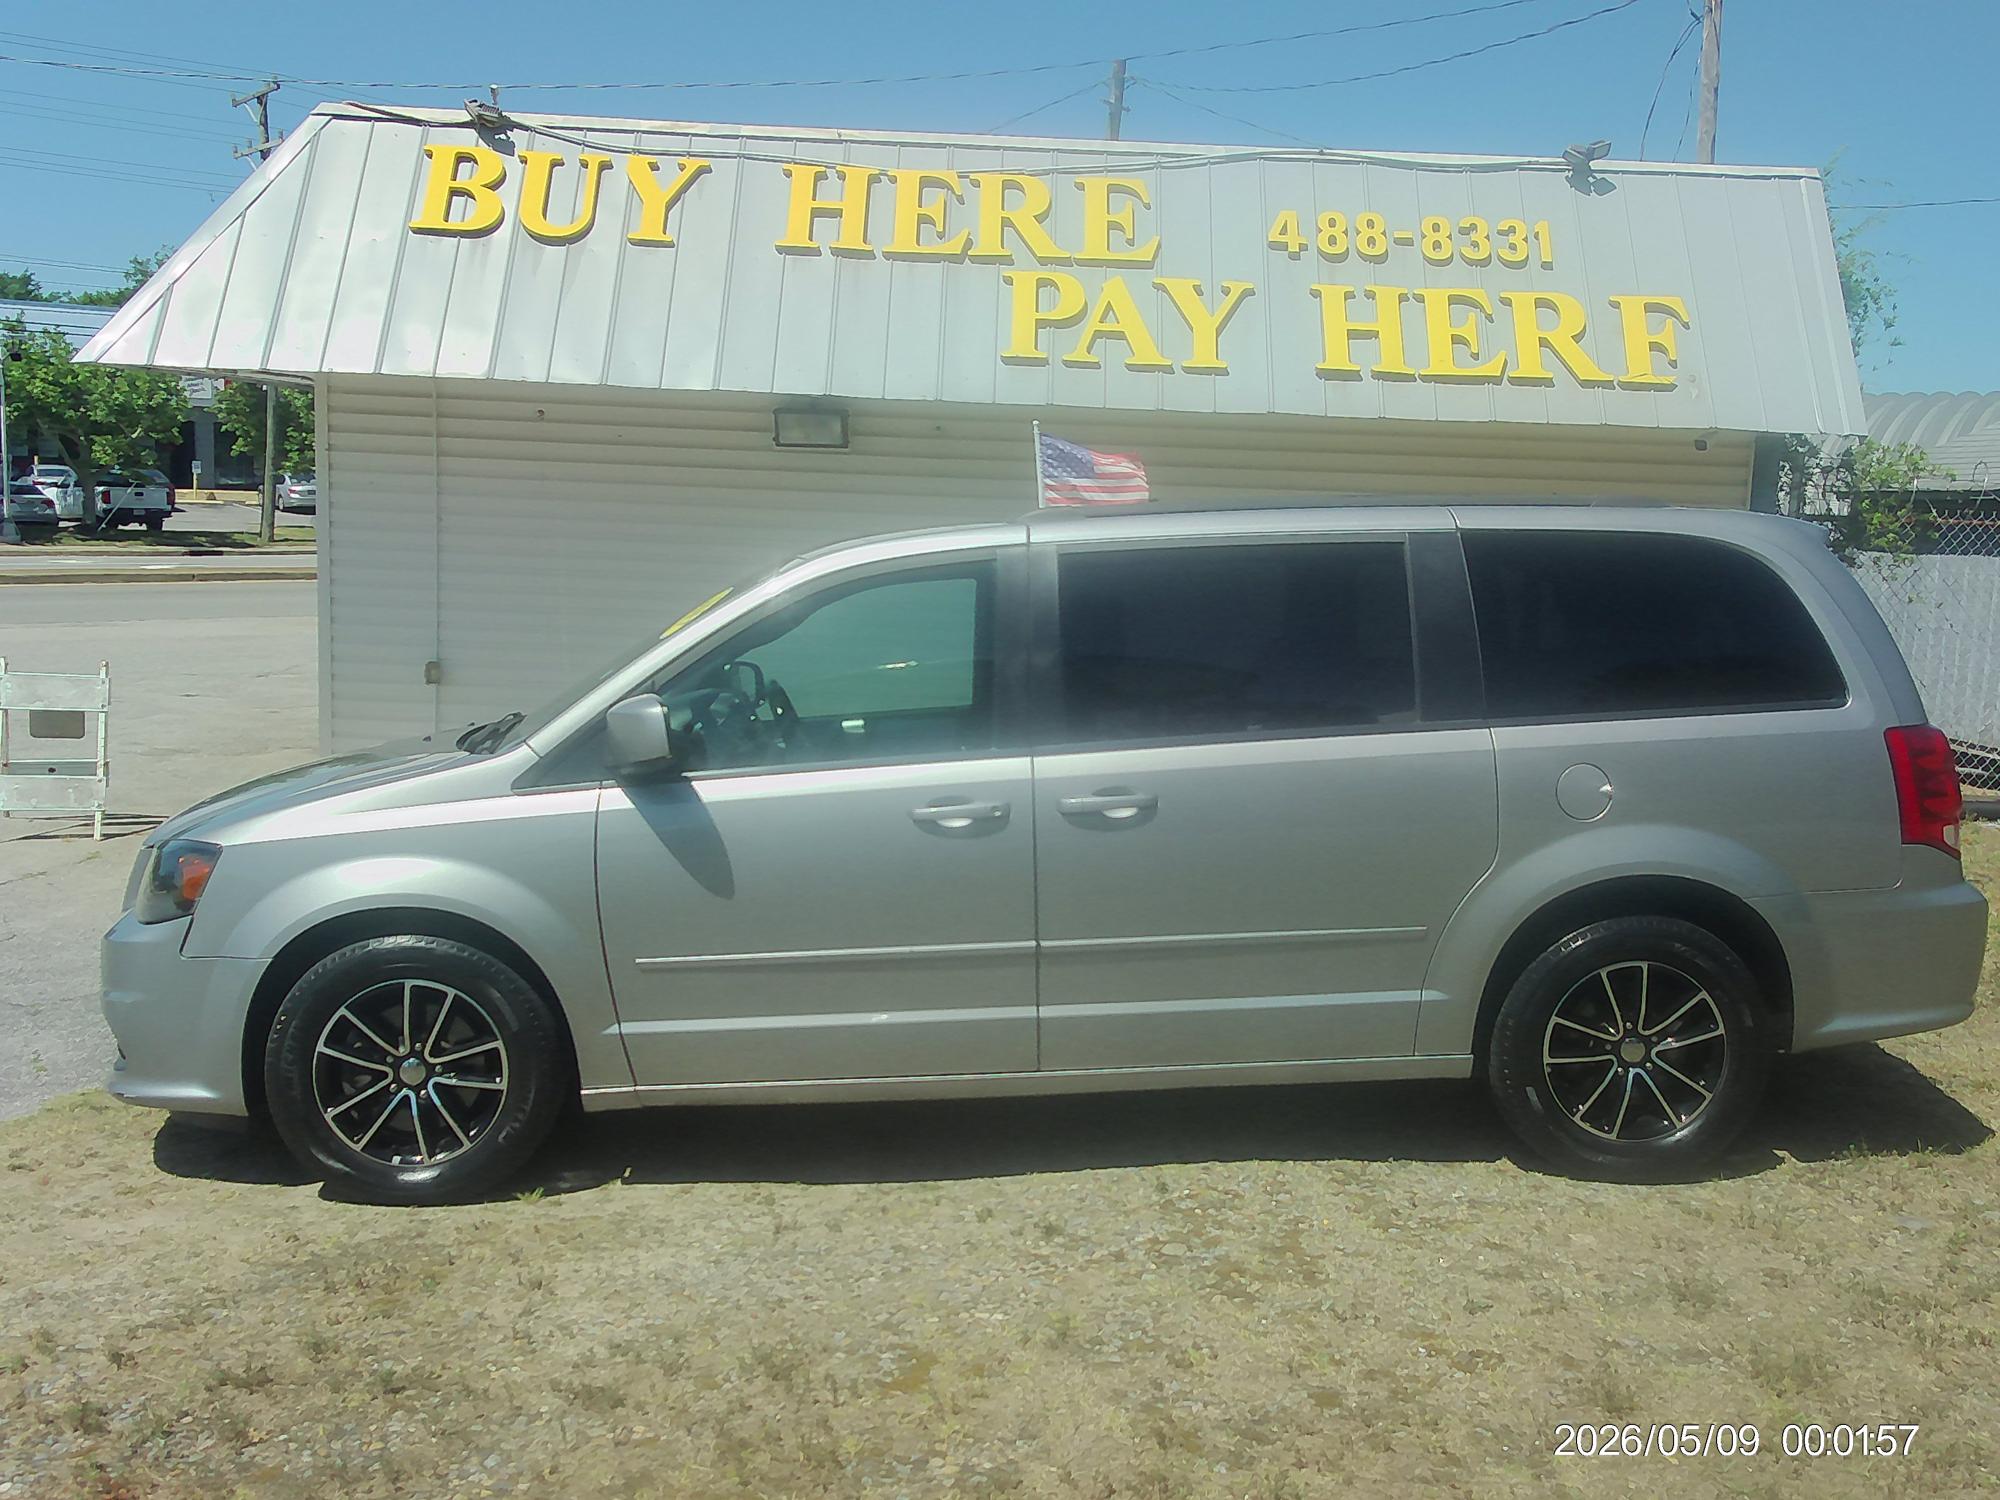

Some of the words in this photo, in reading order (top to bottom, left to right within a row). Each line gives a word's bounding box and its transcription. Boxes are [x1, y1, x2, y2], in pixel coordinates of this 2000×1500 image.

[408, 143, 711, 243] BUY
[775, 163, 1160, 263] HERE
[1268, 210, 1554, 265] 488-8331
[1001, 270, 1255, 369] PAY
